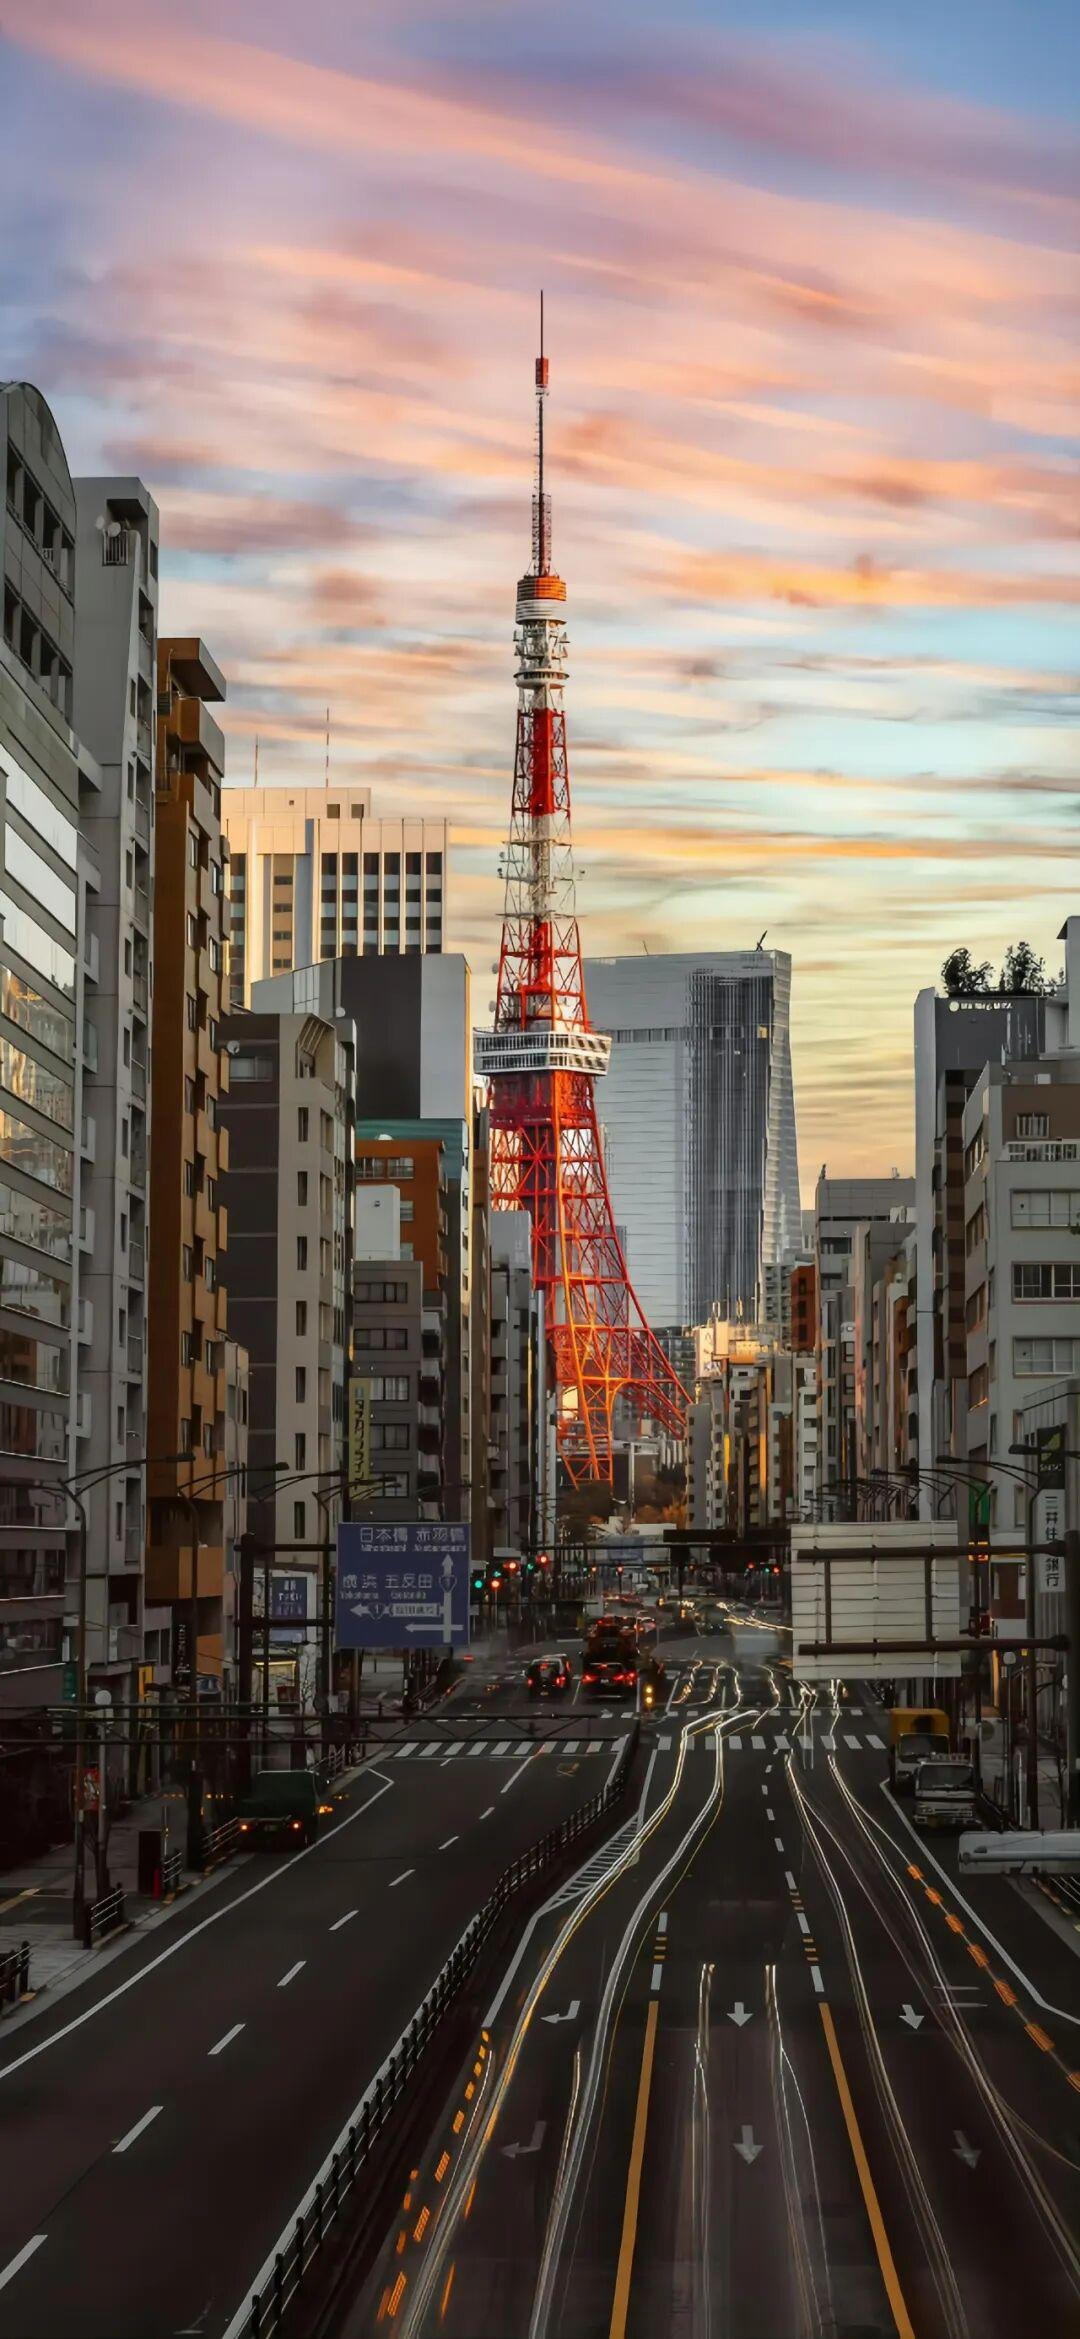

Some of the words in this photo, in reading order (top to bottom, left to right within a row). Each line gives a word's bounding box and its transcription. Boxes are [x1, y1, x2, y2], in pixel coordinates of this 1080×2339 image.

[360, 1527, 408, 1543] 日本橋
[416, 1527, 465, 1543] 赤羽橋
[1045, 1496, 1060, 1587] 三井住銀行
[343, 1574, 378, 1589] 横浜
[384, 1573, 433, 1589] 五反田
